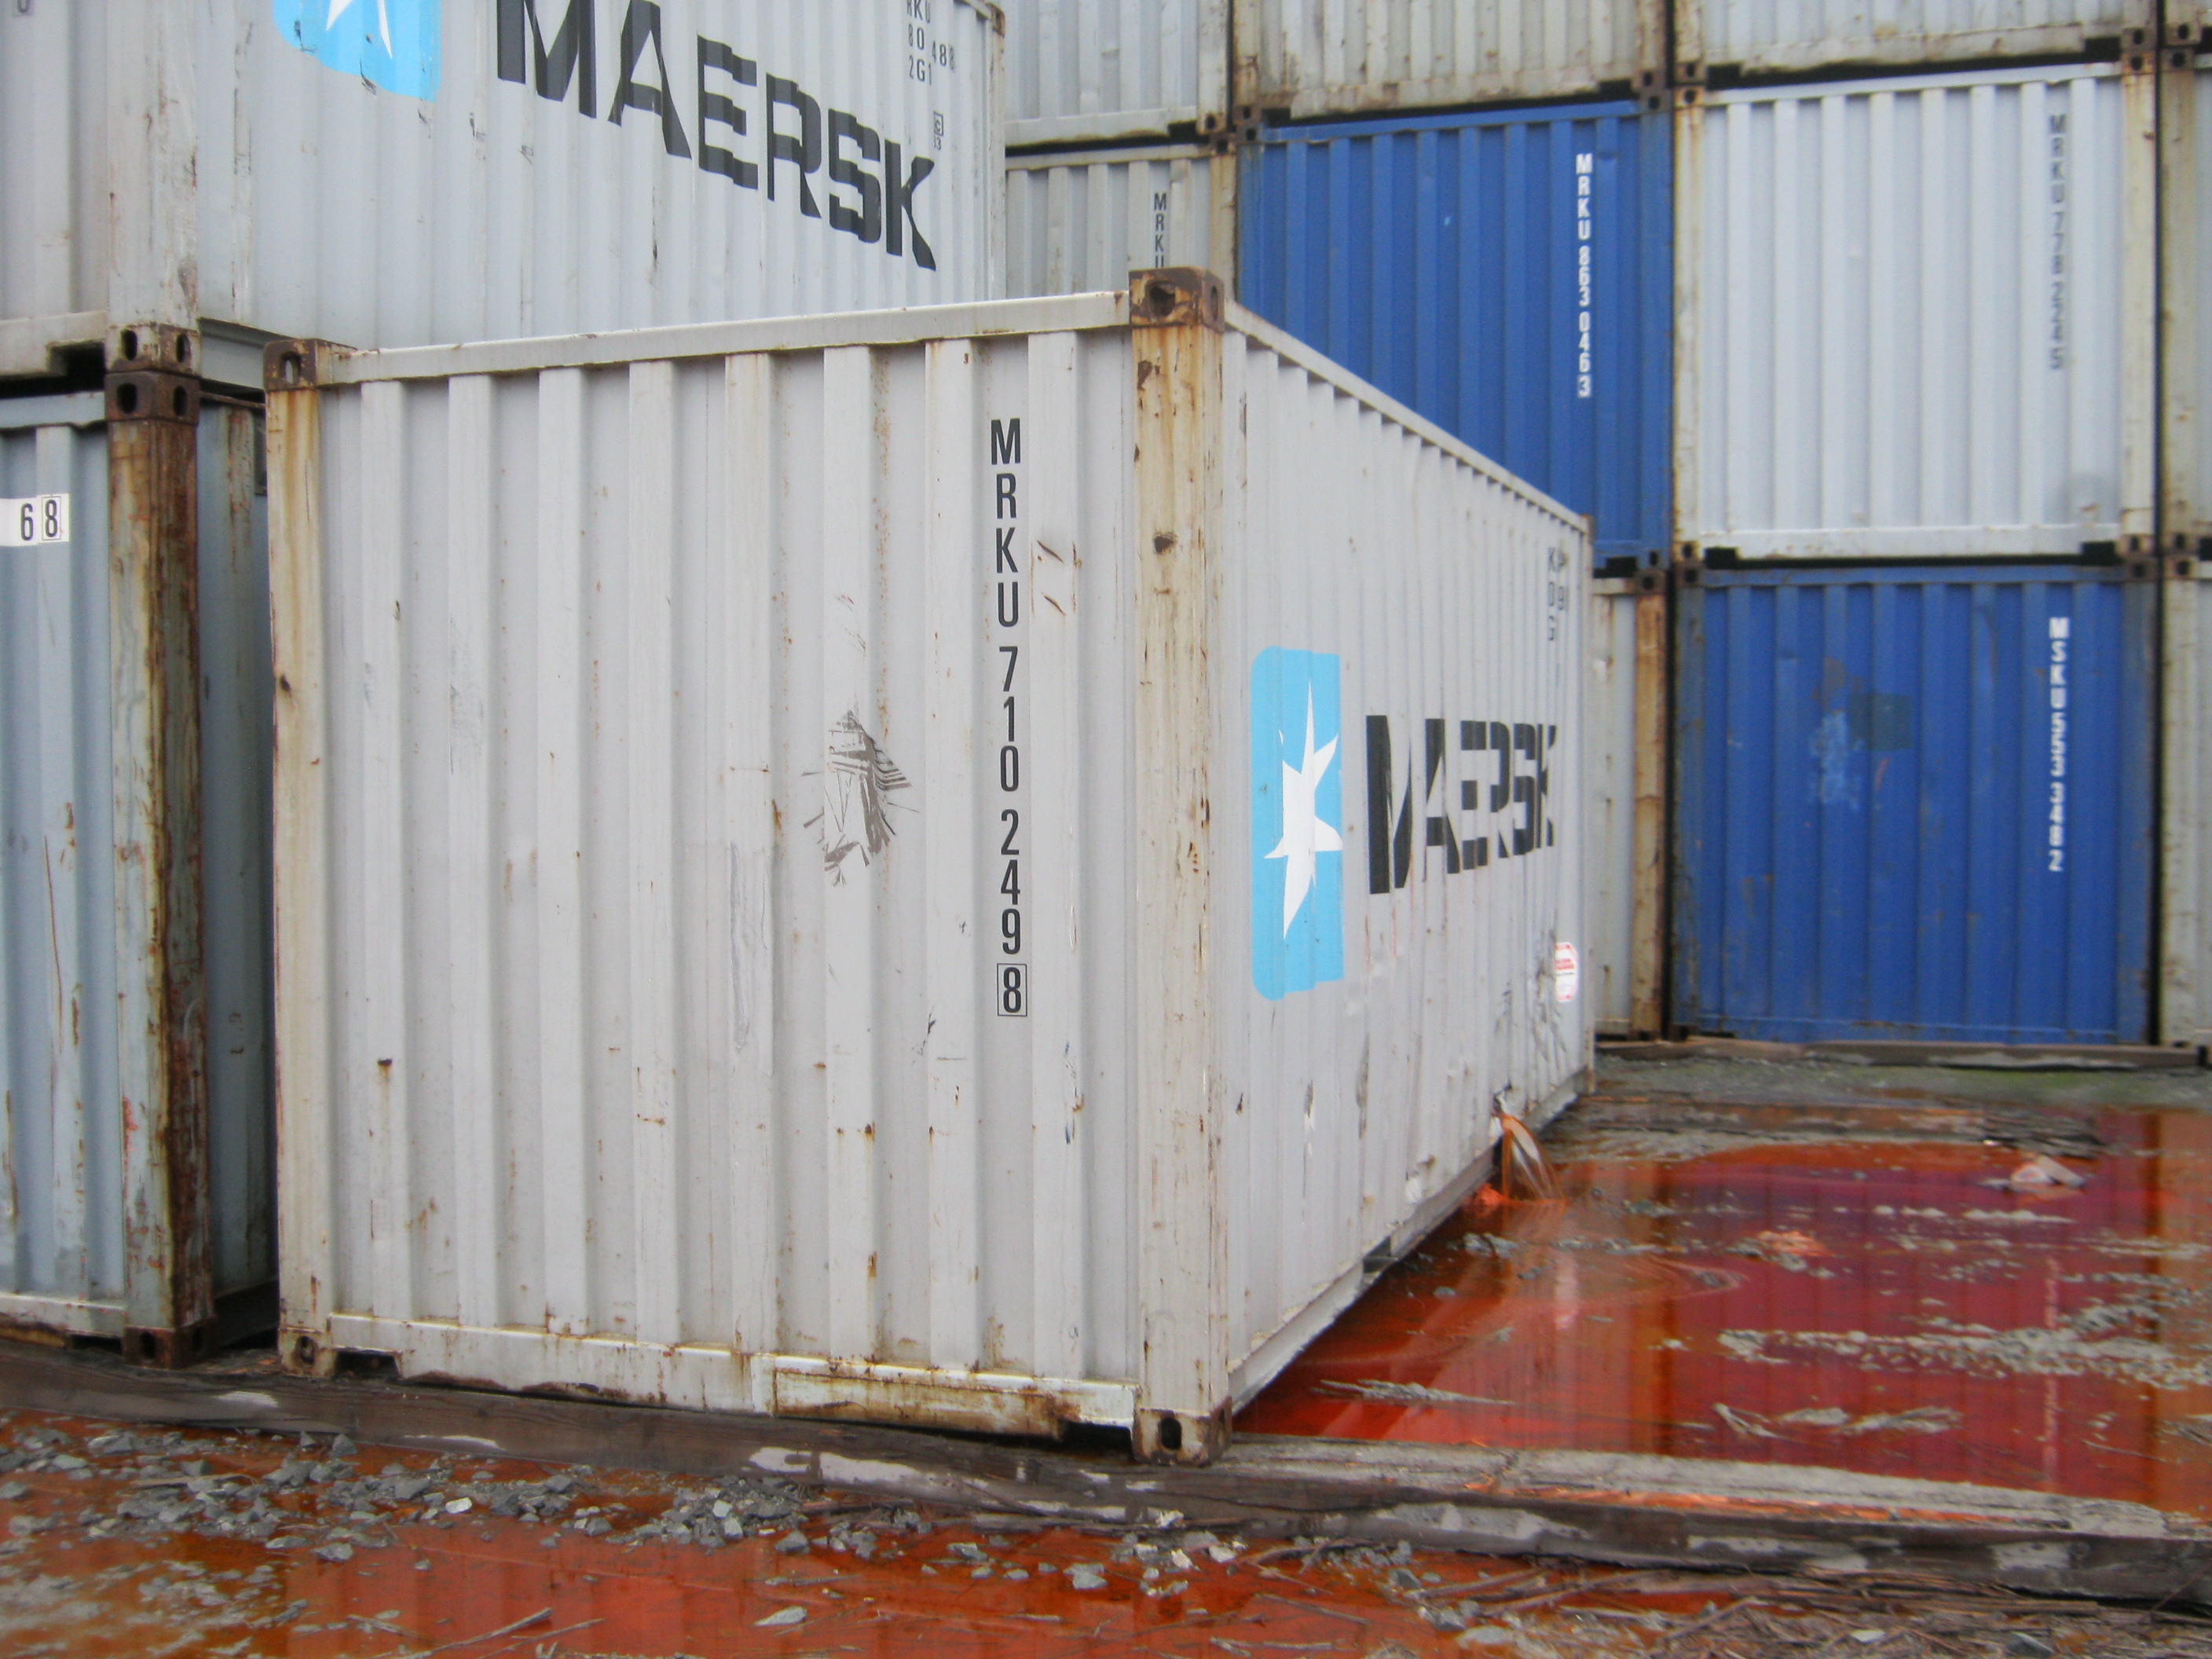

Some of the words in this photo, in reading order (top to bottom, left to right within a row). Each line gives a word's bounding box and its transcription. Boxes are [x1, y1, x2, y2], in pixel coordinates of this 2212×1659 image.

[497, 0, 936, 271] MAERSK
[1576, 153, 1593, 240] MRKU
[2049, 114, 2066, 204] MRKU
[1579, 245, 1591, 307] 863
[991, 419, 1021, 627] MRKU
[998, 646, 1019, 792] 710
[2049, 617, 2069, 709] MSKU
[1366, 715, 1556, 894] MAERSK
[1000, 809, 1021, 954] 249
